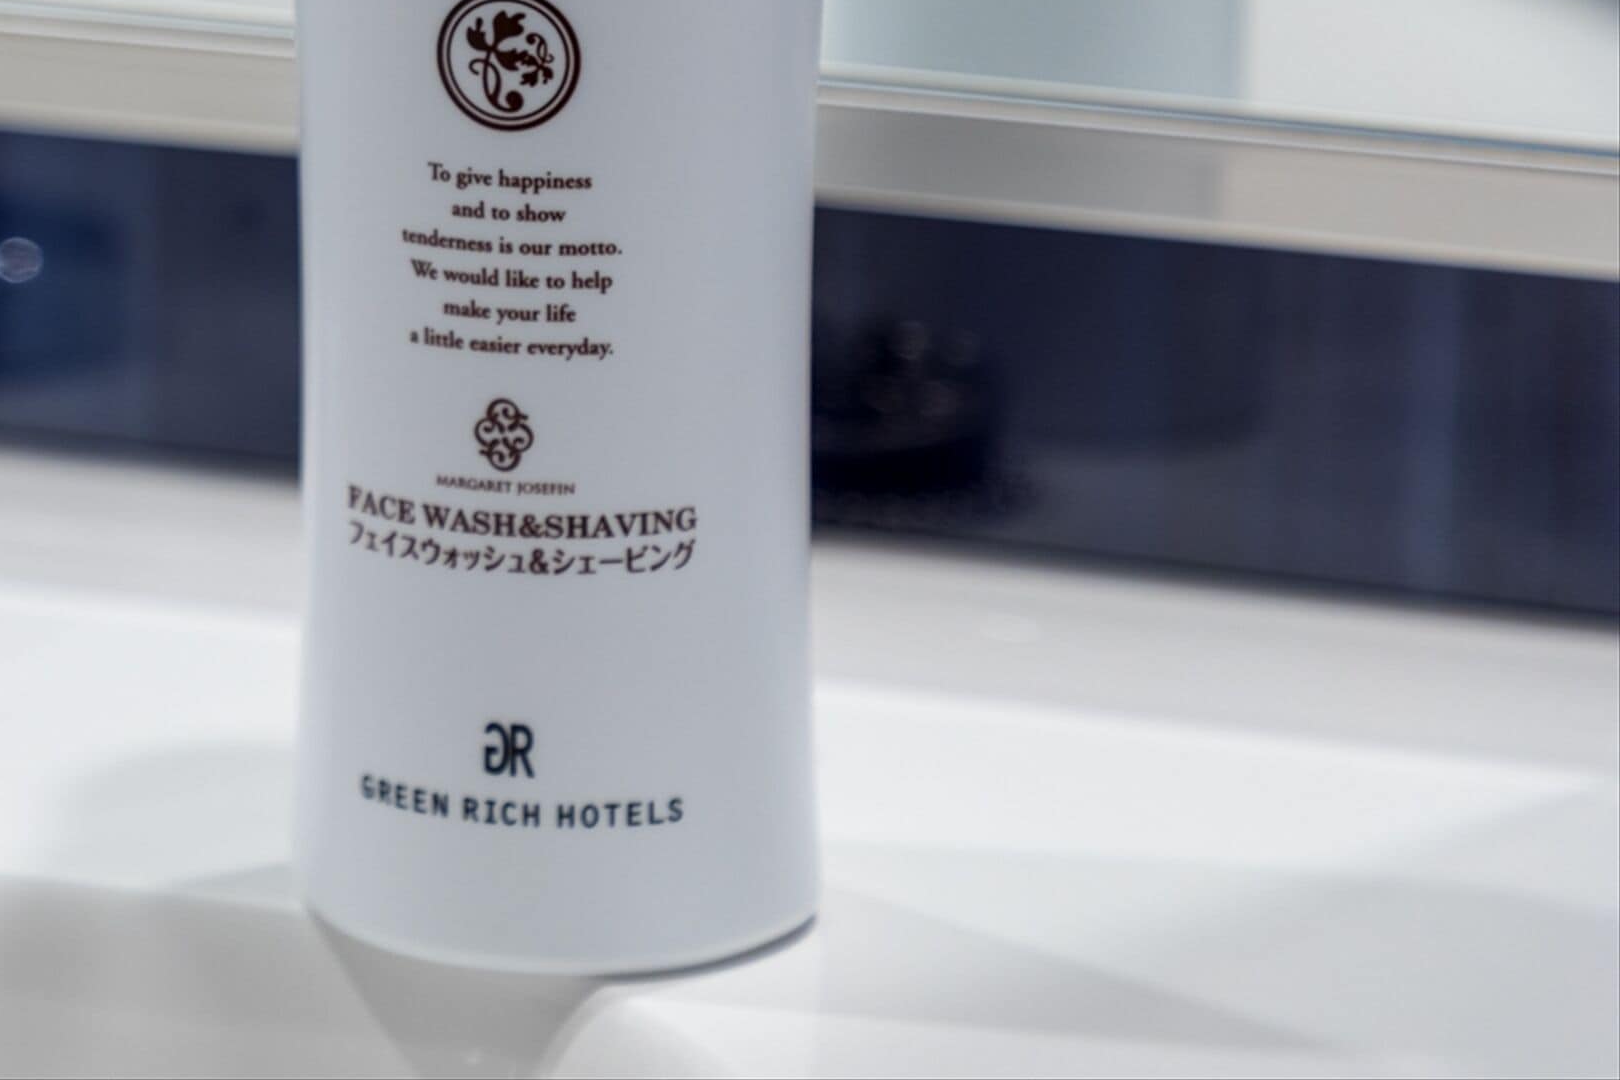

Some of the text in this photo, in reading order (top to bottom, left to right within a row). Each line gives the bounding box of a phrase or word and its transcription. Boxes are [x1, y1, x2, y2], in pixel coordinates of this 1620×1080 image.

[428, 162, 592, 195] To give happiness
[452, 200, 566, 224] and to show
[402, 229, 623, 257] tenderness is our motto.
[410, 259, 613, 294] We would like to help
[443, 299, 577, 326] make your life
[410, 328, 614, 361] a little easier everyday.
[436, 475, 576, 496] MARGARET JOSEFIN
[347, 485, 699, 539] FACE WASH&SHAVING
[361, 774, 684, 829] GREEN RICH HOTELS
